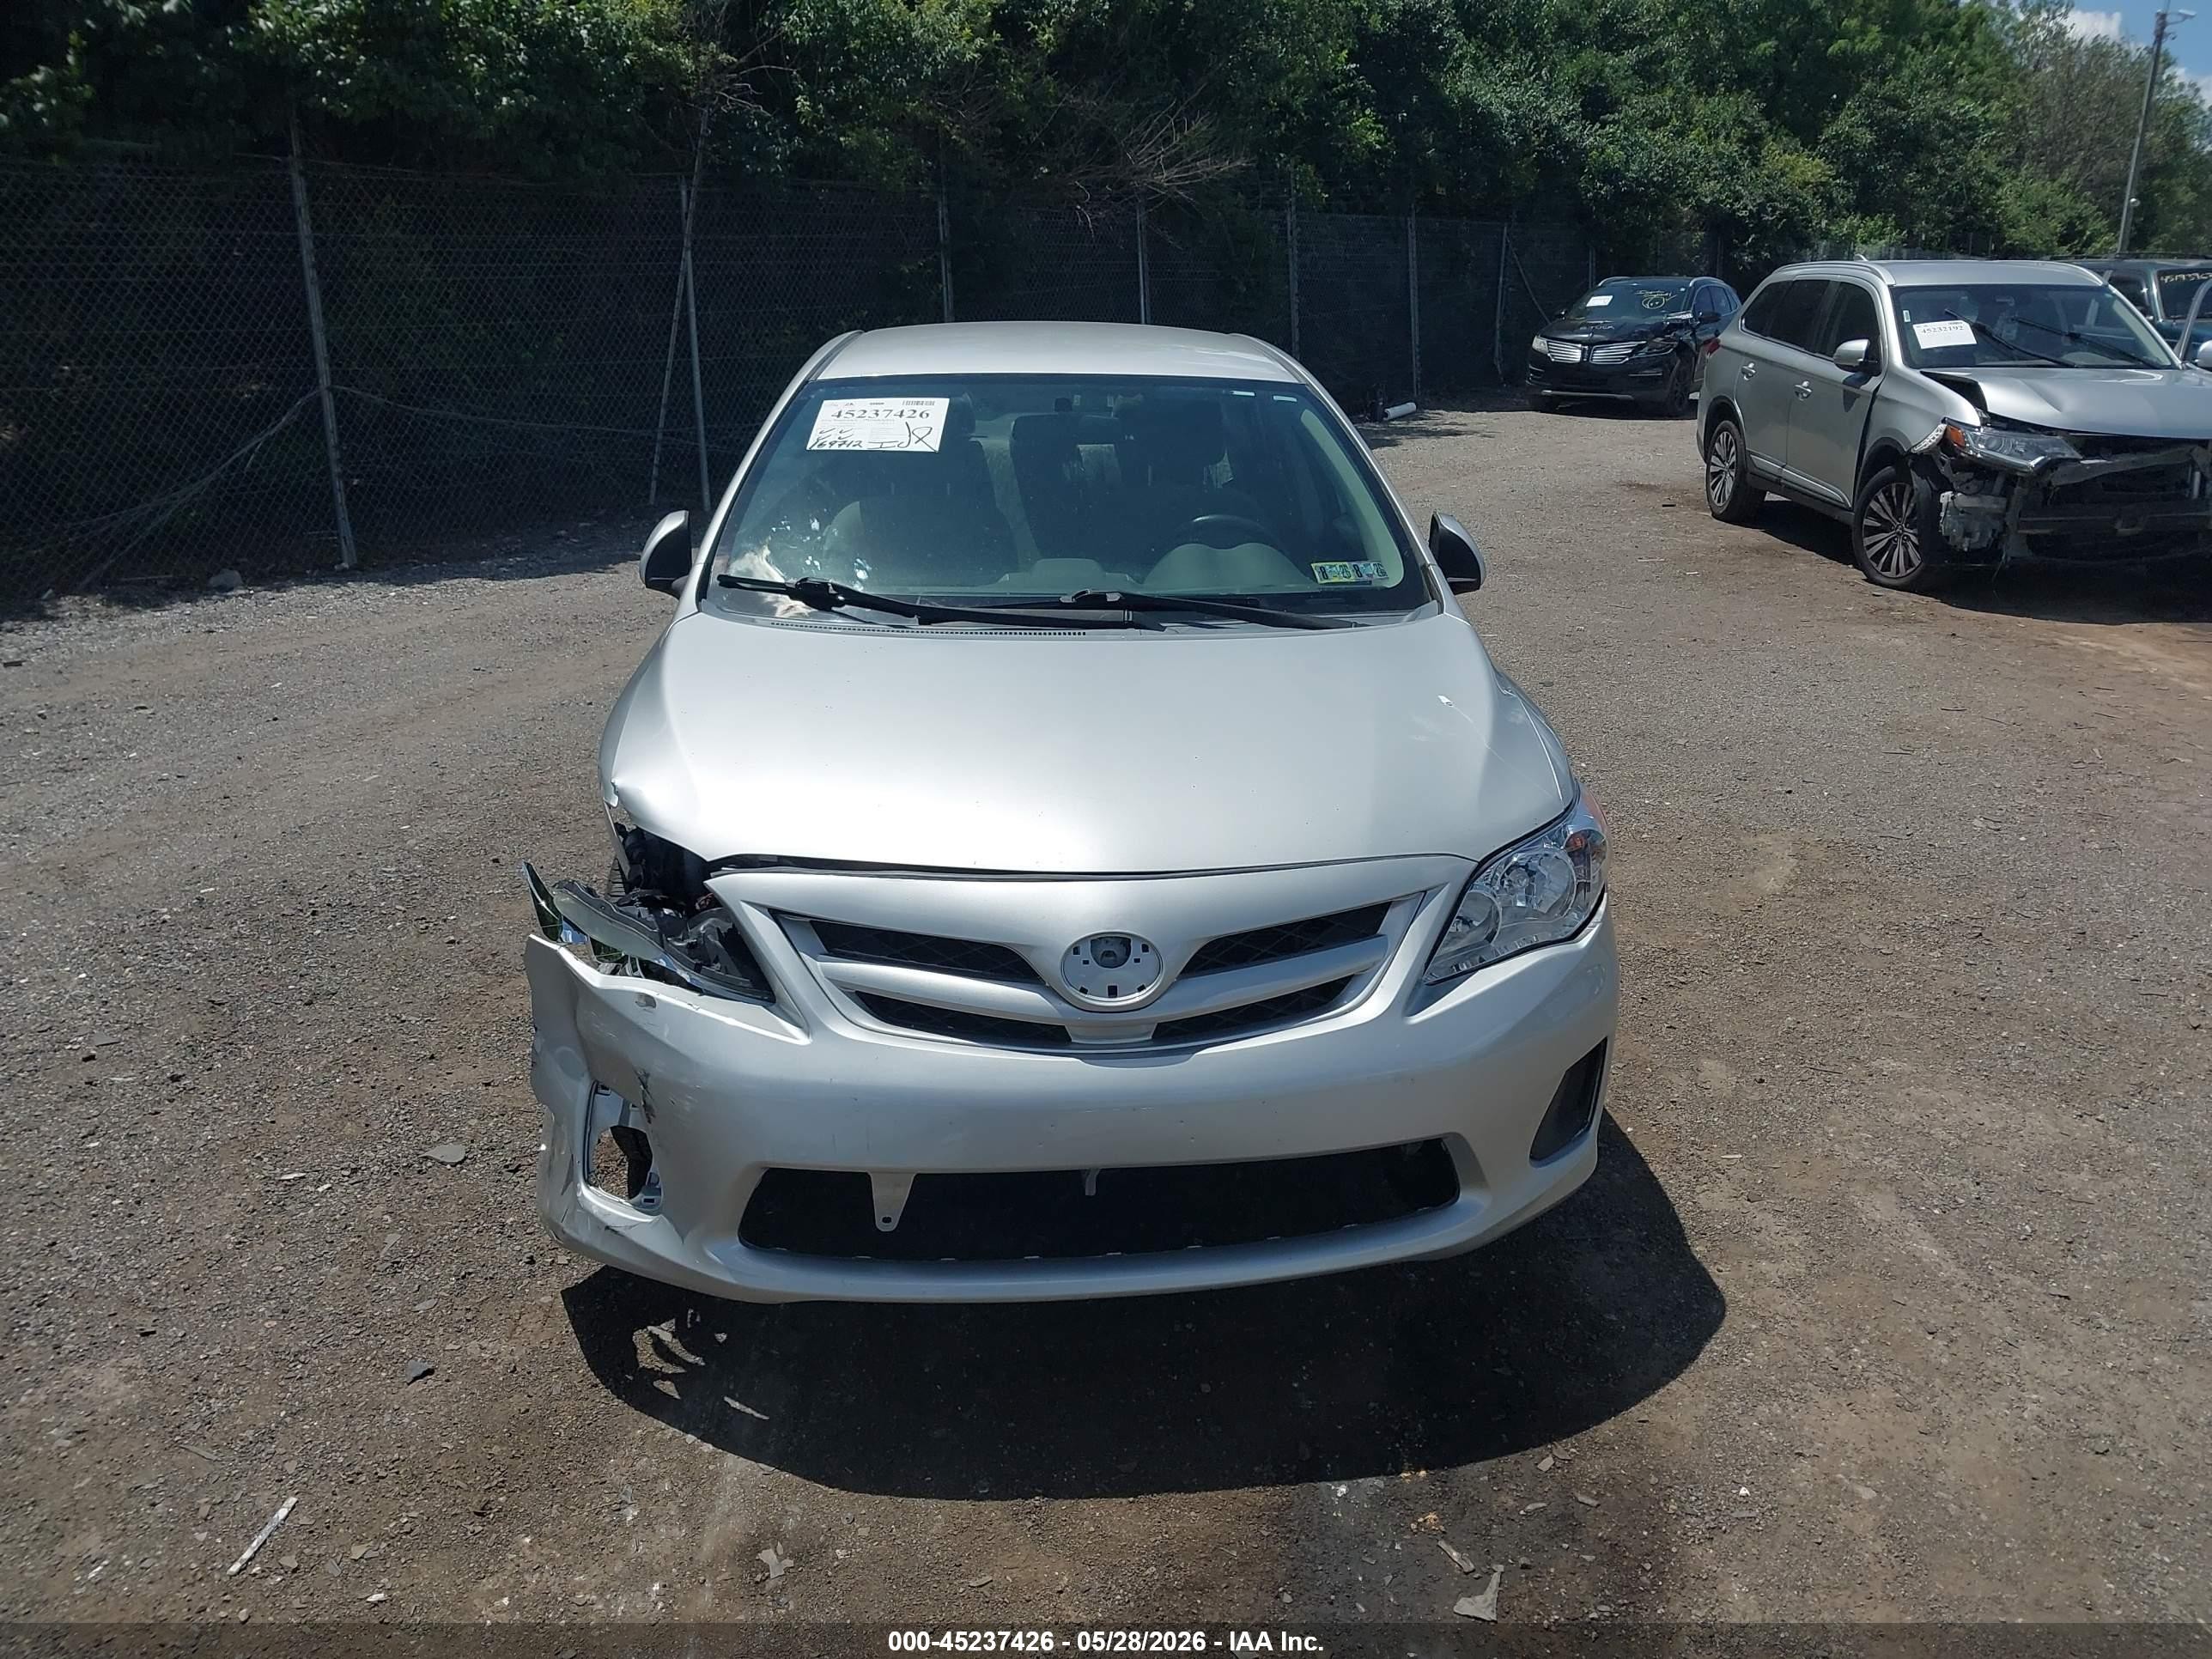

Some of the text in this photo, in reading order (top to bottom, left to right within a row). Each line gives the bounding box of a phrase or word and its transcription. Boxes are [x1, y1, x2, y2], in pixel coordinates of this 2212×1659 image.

[830, 409, 930, 419] 45237426
[1319, 566, 1329, 580] 8
[1352, 563, 1363, 578] 8
